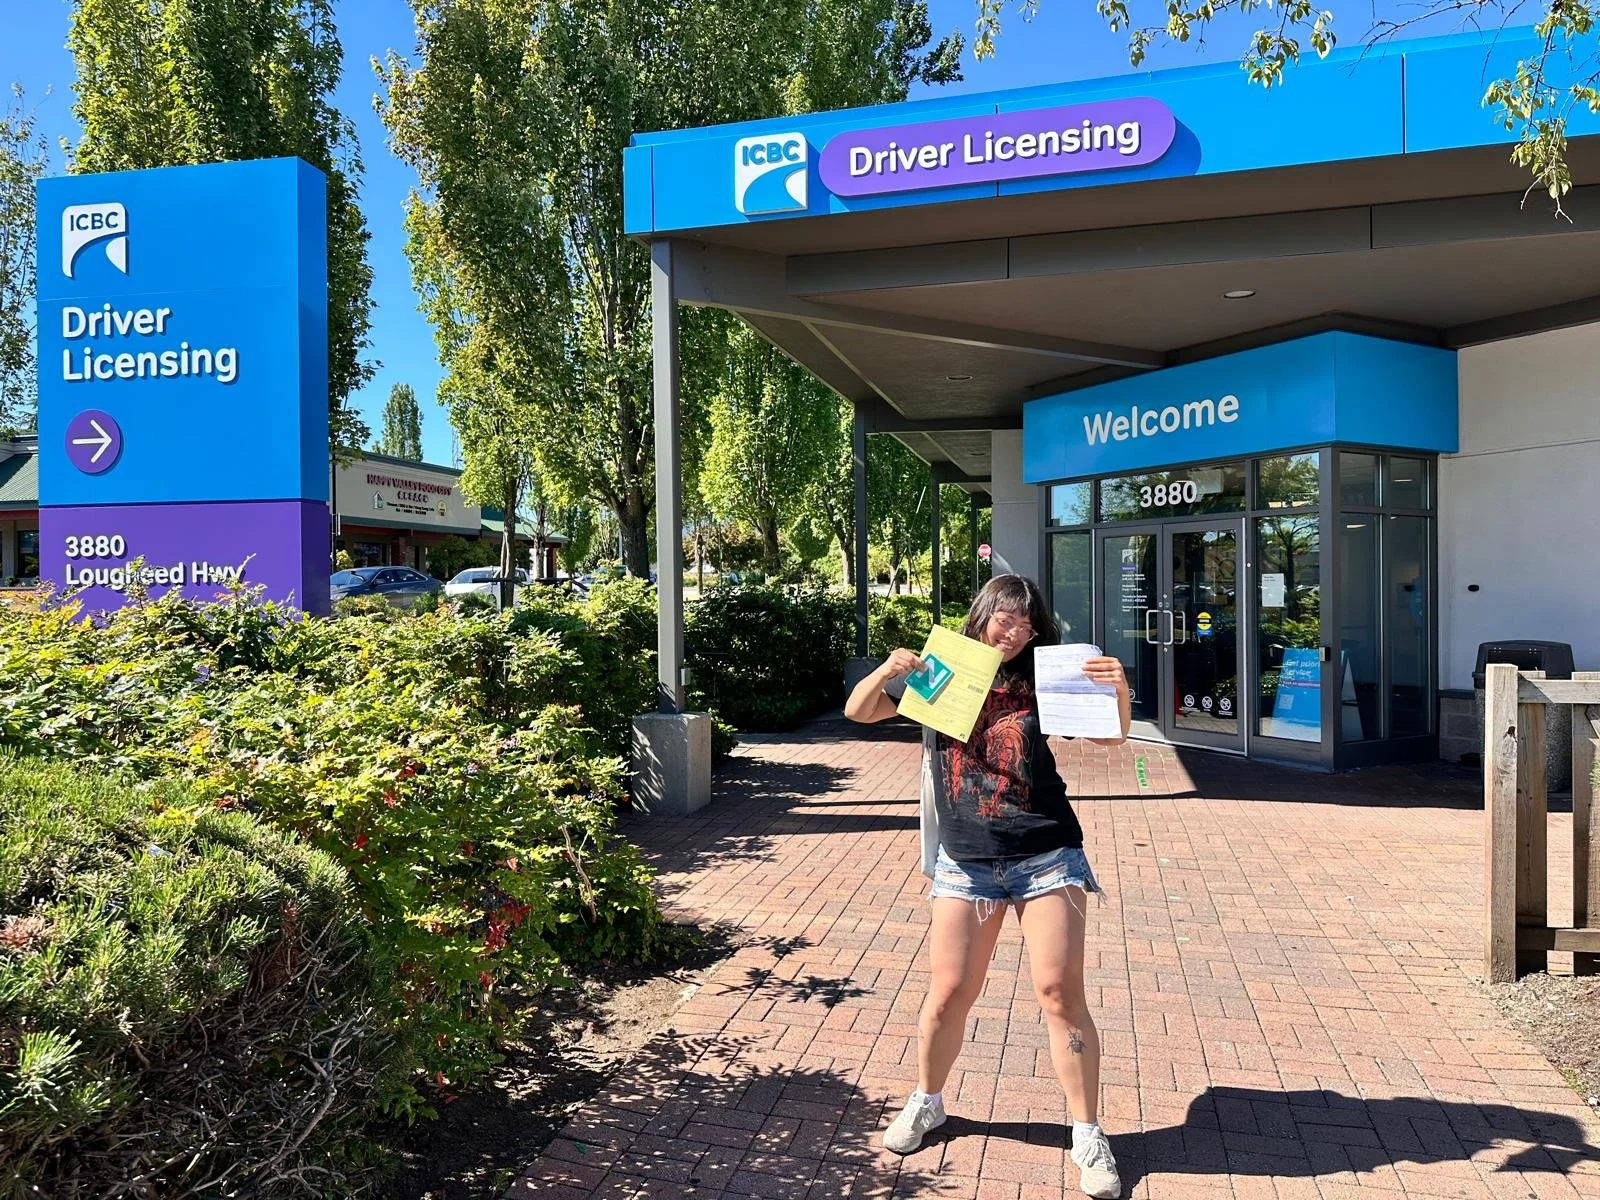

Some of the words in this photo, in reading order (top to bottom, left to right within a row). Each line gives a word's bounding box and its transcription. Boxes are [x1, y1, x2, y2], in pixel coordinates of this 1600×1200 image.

[742, 140, 801, 168] ICBC
[849, 140, 954, 177] Driver
[963, 119, 1140, 165] Licensing
[69, 211, 119, 232] ICBC
[62, 302, 171, 339] Driver
[62, 341, 238, 383] Licensing
[1082, 394, 1240, 446] Welcome
[1139, 480, 1198, 508] 3880
[65, 535, 126, 559] 3880
[915, 657, 948, 689] N
